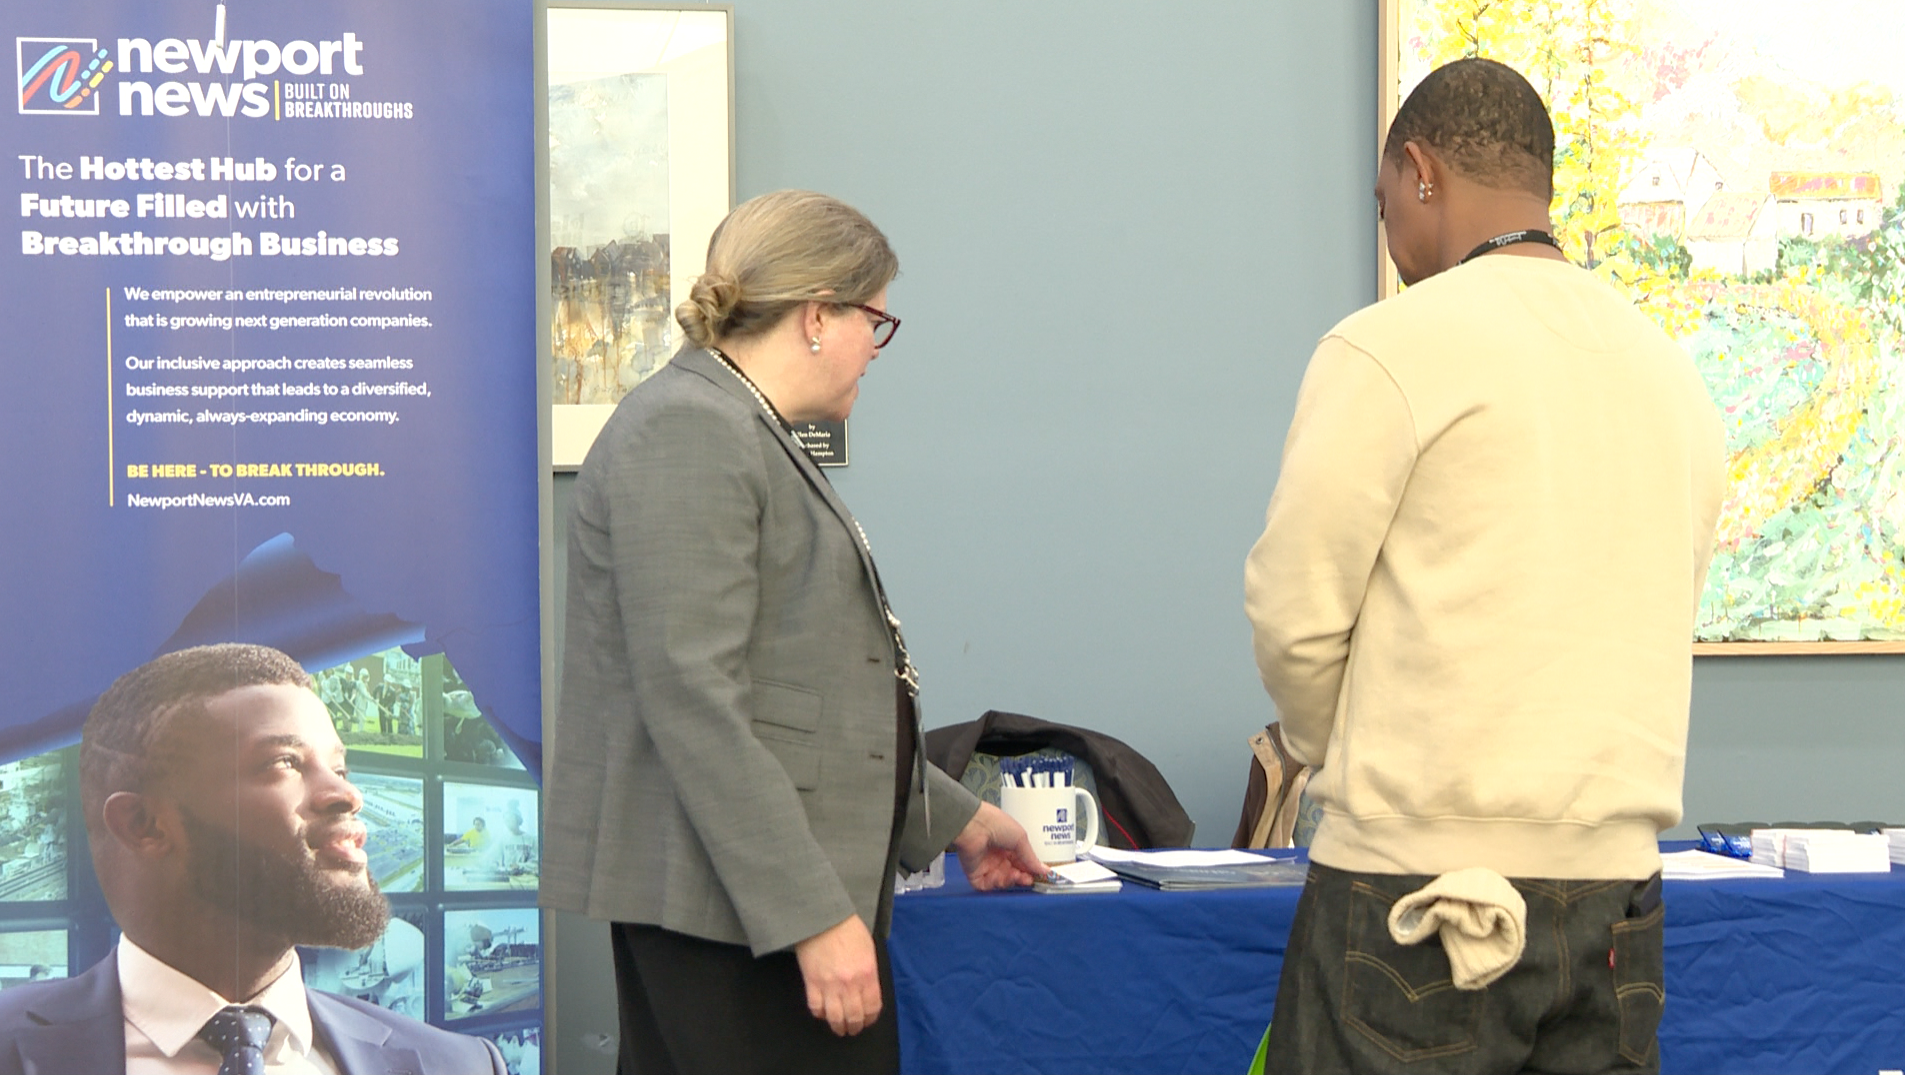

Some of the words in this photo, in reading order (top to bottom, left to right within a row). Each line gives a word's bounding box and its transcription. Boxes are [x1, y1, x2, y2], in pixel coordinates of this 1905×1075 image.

[118, 32, 364, 78] newport
[119, 79, 270, 118] news
[284, 83, 325, 100] BUILT
[330, 83, 350, 100] ON
[284, 101, 414, 120] BREAKTHROUGHS
[19, 156, 74, 180] The
[80, 156, 205, 181] Hottest
[211, 157, 277, 182] Hub
[284, 158, 325, 182] for
[331, 165, 346, 182] a
[21, 194, 130, 218] Future
[137, 193, 228, 219] Filled
[235, 195, 295, 219] with
[21, 231, 253, 261] Breakthrough
[260, 231, 400, 257] Business
[124, 287, 150, 301] We
[151, 290, 223, 304] empower
[225, 290, 244, 301] an
[246, 287, 357, 304] entrepreneurial
[359, 287, 433, 302] revolution
[125, 314, 154, 327] that
[156, 314, 168, 327] is
[170, 314, 233, 331] growing
[235, 315, 268, 328] next
[269, 314, 348, 331] generation
[350, 314, 433, 331] companies.
[126, 356, 155, 370] Our
[157, 356, 221, 370] inclusive
[222, 356, 292, 373] approach
[294, 357, 347, 370] creates
[348, 356, 414, 370] seamless
[127, 383, 189, 397] business
[191, 384, 249, 400] support
[251, 383, 280, 396] that
[282, 383, 321, 396] leads
[323, 384, 338, 396] to
[341, 386, 350, 396] a
[352, 382, 432, 398] diversified,
[127, 409, 194, 426] dynamic,
[196, 409, 328, 426] always-expanding
[330, 410, 400, 426] economy.
[808, 423, 816, 431] by
[127, 464, 149, 478] BE
[152, 464, 197, 478] HERE
[209, 464, 233, 478] TO
[236, 464, 293, 478] BREAK
[295, 463, 386, 477] THROUGH.
[127, 493, 291, 510] NewportNewsVA.com
